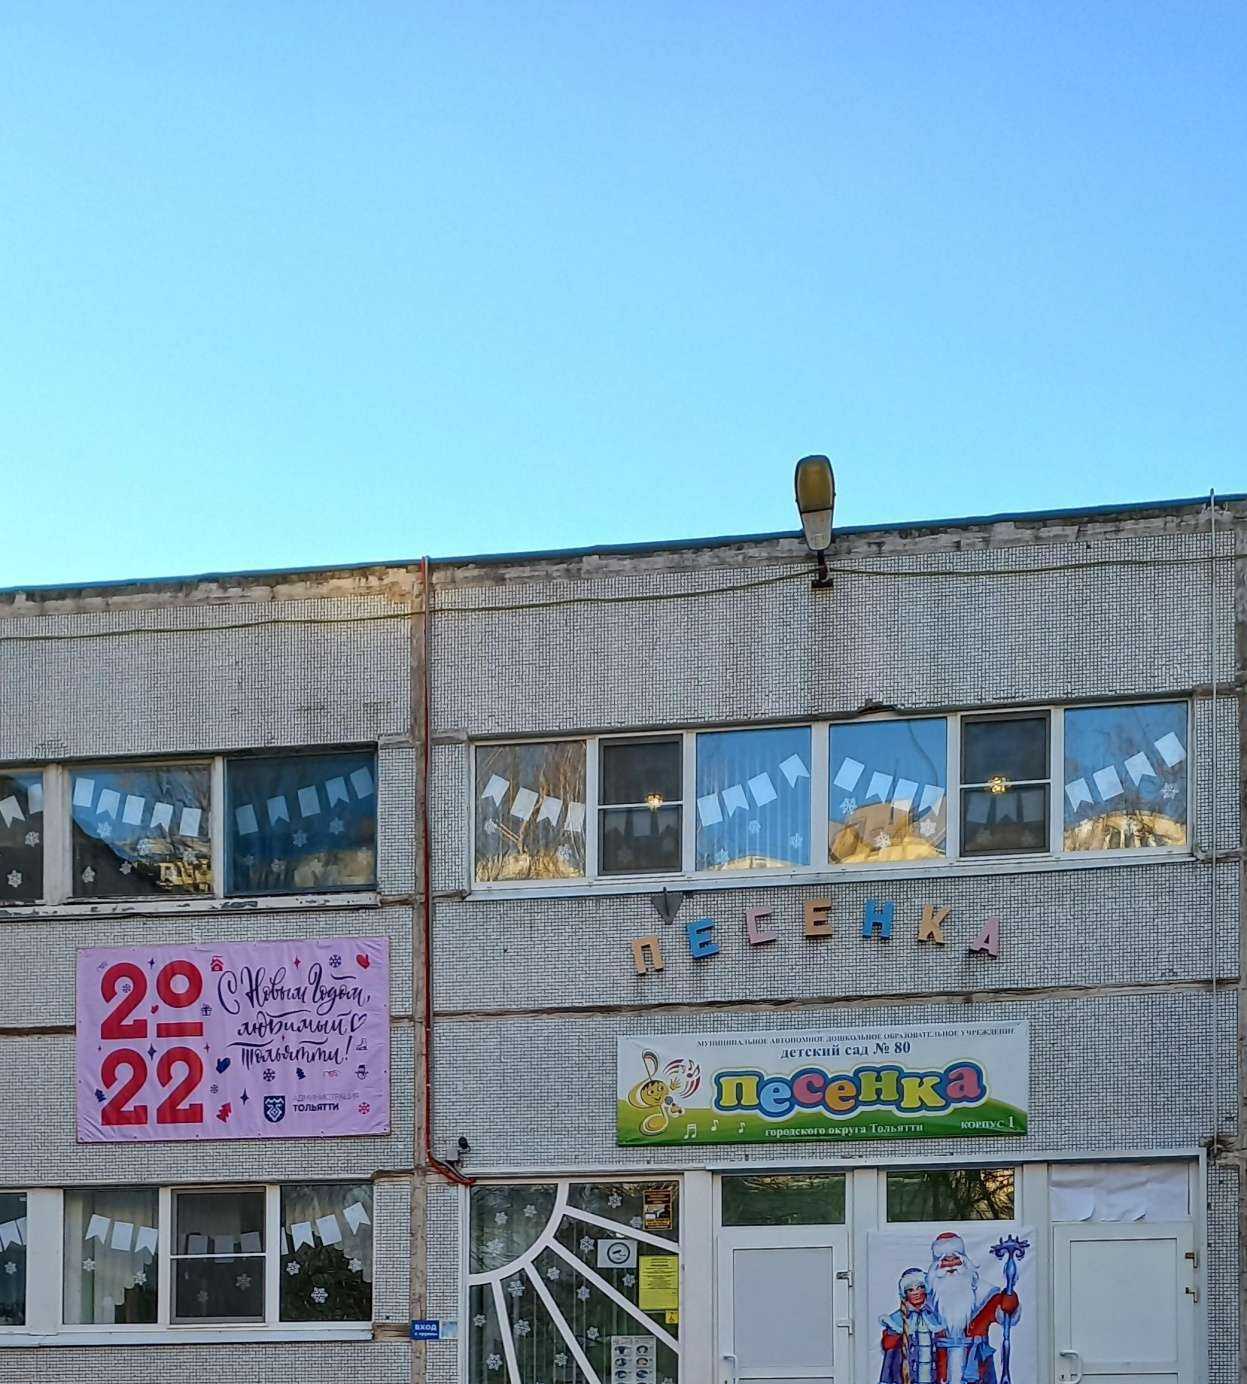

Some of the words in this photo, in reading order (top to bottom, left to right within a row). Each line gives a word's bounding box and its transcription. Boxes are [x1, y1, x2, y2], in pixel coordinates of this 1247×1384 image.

[631, 897, 1001, 975] ПЕСЕНКА
[217, 970, 240, 1015] С
[240, 966, 308, 1009] Новым
[237, 1010, 349, 1038] любимый
[770, 1036, 823, 1045] АВТОНОМНОЕ
[826, 1033, 881, 1043] ДОШКОЛЬНОЕ
[780, 1044, 841, 1059] детский
[844, 1046, 869, 1057] сад
[873, 1042, 890, 1055] №
[894, 1041, 911, 1054] 80
[100, 1046, 203, 1126] 22
[717, 1062, 984, 1115] песенка
[292, 1102, 340, 1112] ТОЛЬЯТТИ
[765, 1126, 826, 1138] городского
[828, 1125, 867, 1136] округа
[871, 1122, 924, 1135] Тольятти
[1007, 1116, 1015, 1129] 1
